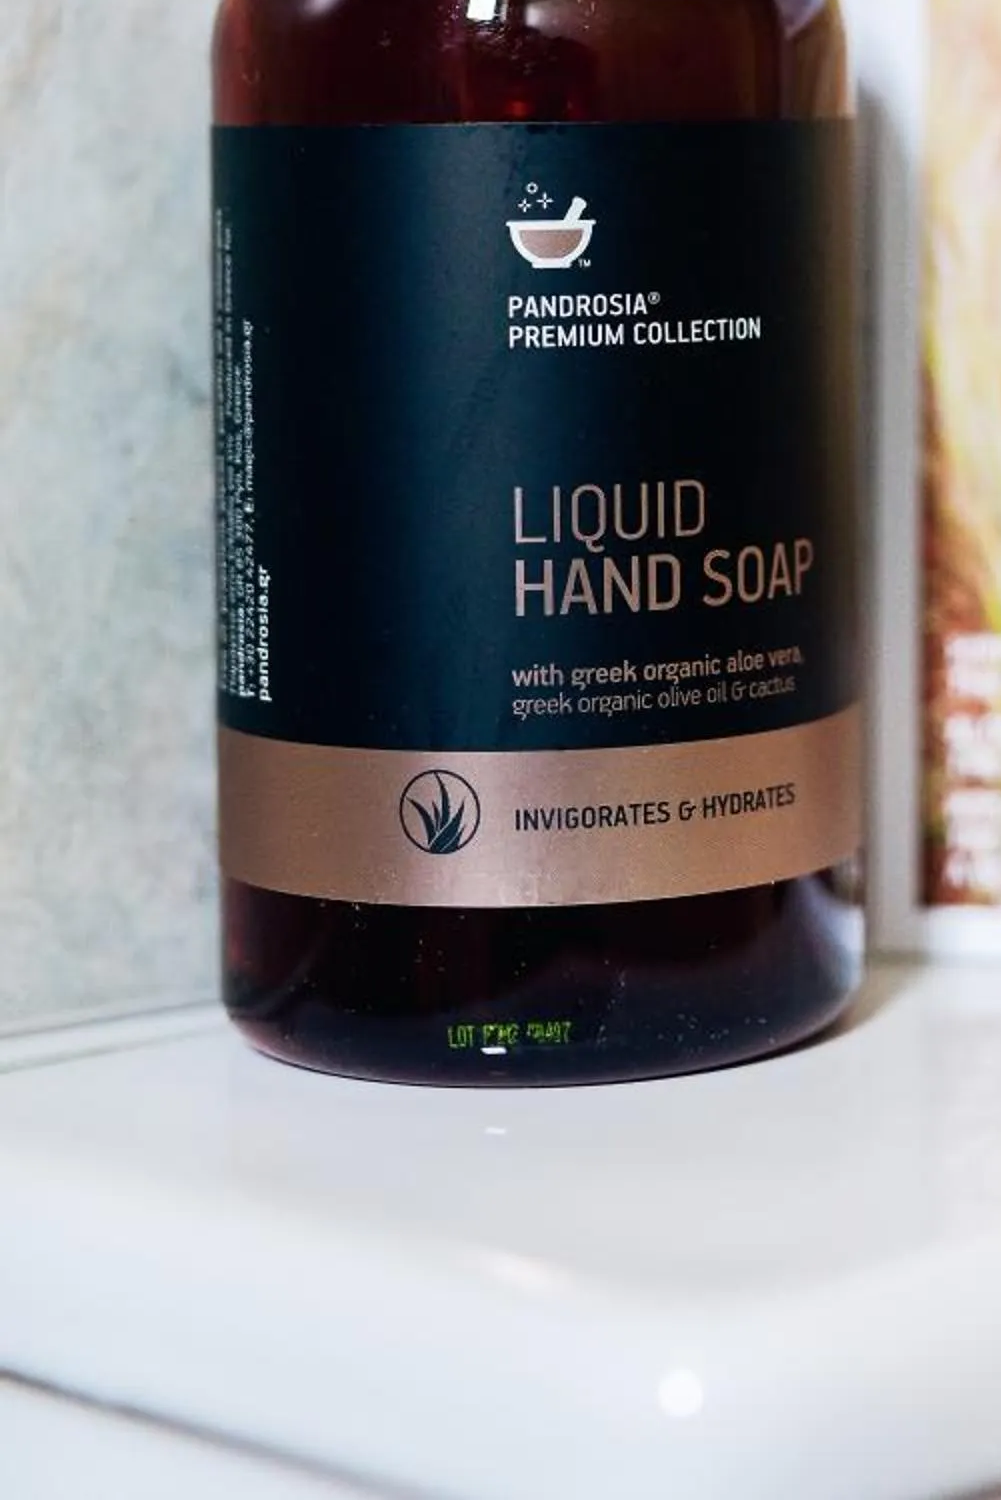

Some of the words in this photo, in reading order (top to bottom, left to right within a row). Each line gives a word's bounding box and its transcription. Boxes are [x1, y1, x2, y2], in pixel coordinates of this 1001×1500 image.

[508, 323, 625, 349] PREMIUM
[633, 316, 762, 345] COLLECTION
[513, 479, 706, 553] LIQUID
[514, 553, 682, 617] HAND
[702, 538, 815, 608] SOAP
[256, 564, 272, 702] pandrosia.gr
[511, 663, 565, 688] with
[571, 660, 638, 691] greek
[643, 653, 721, 685] organic
[727, 649, 764, 674] aloe
[511, 691, 574, 721] greek
[577, 689, 653, 718] organic
[657, 685, 702, 709] olive
[706, 680, 727, 703] oil
[731, 681, 748, 702] &
[749, 676, 796, 700] cactus
[514, 800, 671, 831] INVIGORATES
[678, 801, 697, 821] &
[700, 783, 797, 819] HYDRATES
[446, 1024, 475, 1049] LOT
